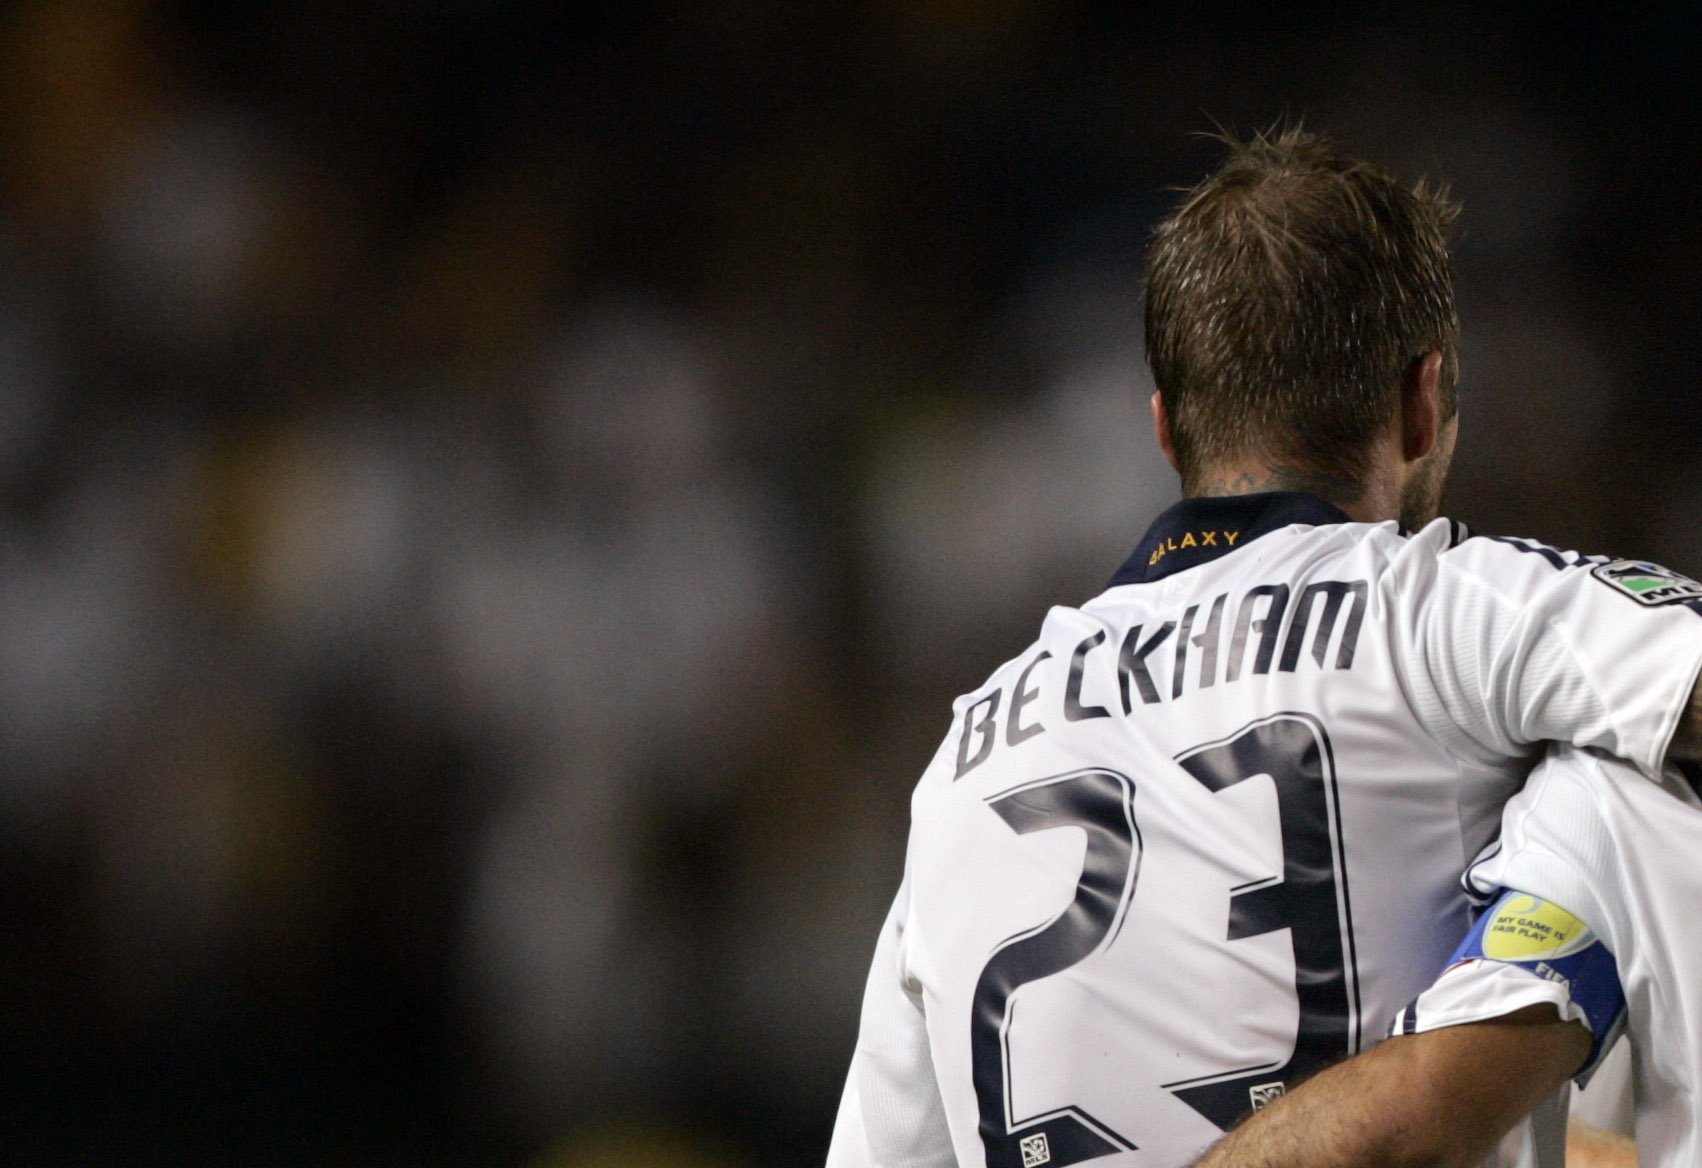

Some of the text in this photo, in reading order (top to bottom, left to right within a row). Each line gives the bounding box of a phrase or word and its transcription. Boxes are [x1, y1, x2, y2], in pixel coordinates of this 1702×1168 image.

[1148, 530, 1239, 567] GALAXY
[952, 578, 1370, 784] BECKHAM
[1494, 925, 1548, 942] FAIR PLAY
[1496, 916, 1515, 924] MY
[1518, 919, 1552, 934] GAME
